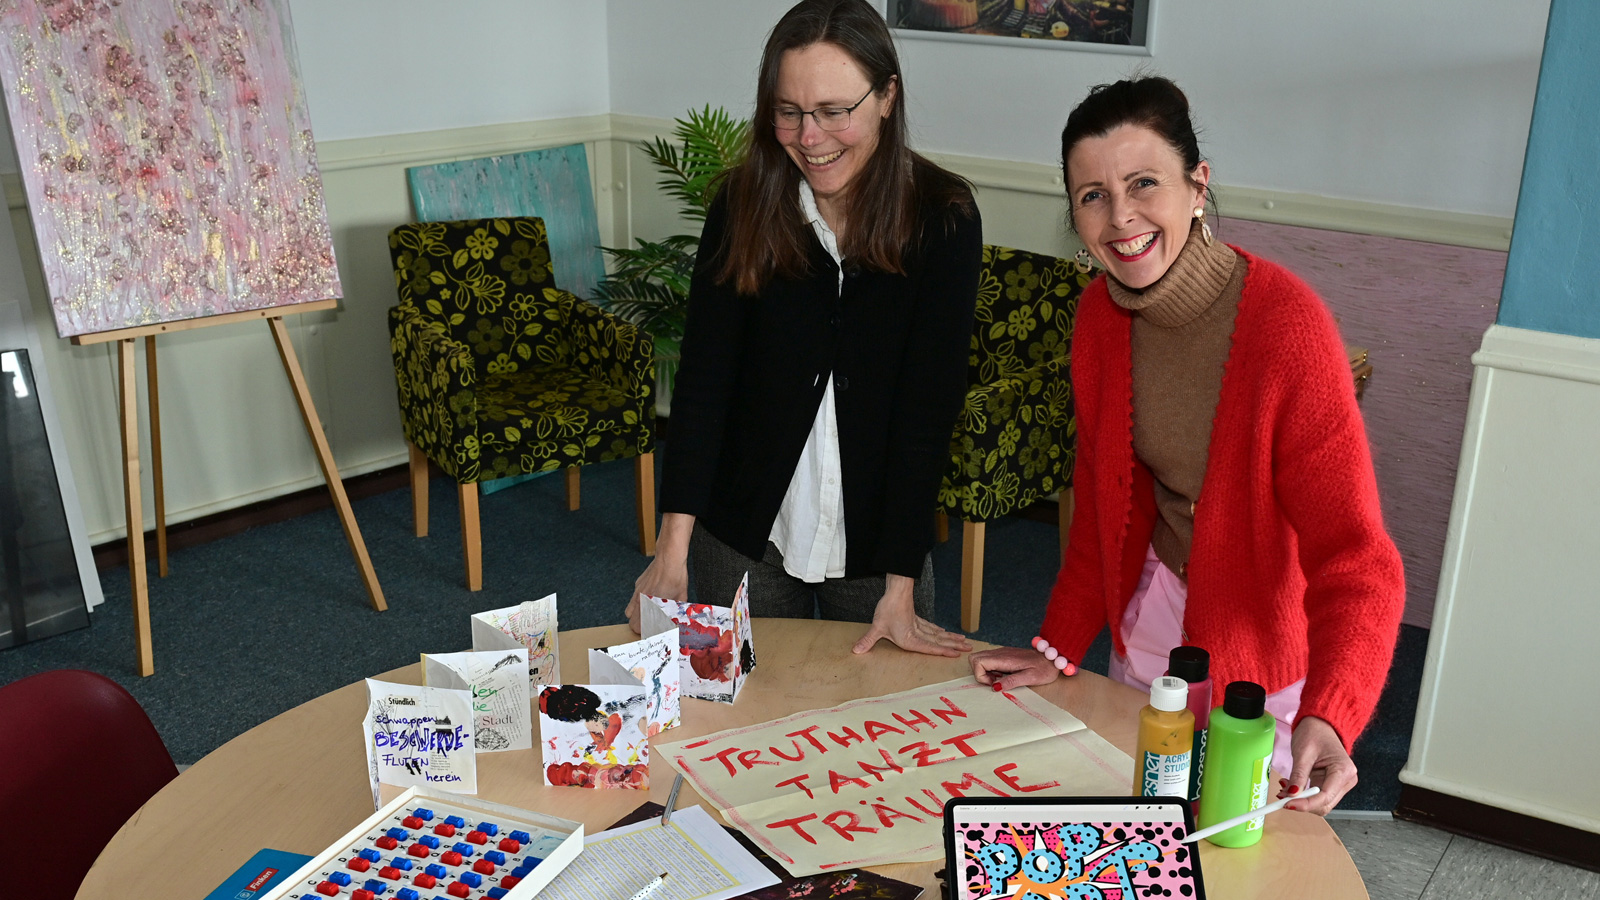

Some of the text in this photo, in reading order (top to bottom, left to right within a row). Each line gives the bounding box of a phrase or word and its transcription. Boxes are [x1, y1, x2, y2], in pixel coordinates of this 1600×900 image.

[388, 697, 416, 706] Stündlich
[375, 713, 437, 728] schwappen
[482, 714, 513, 726] Stadt
[700, 696, 968, 778] TRUTHAHN
[775, 729, 986, 799] TANZT
[1164, 752, 1189, 764] ACRYL
[425, 771, 462, 782] herein
[766, 763, 1061, 844] TRÄUME
[249, 870, 273, 890] Finken
